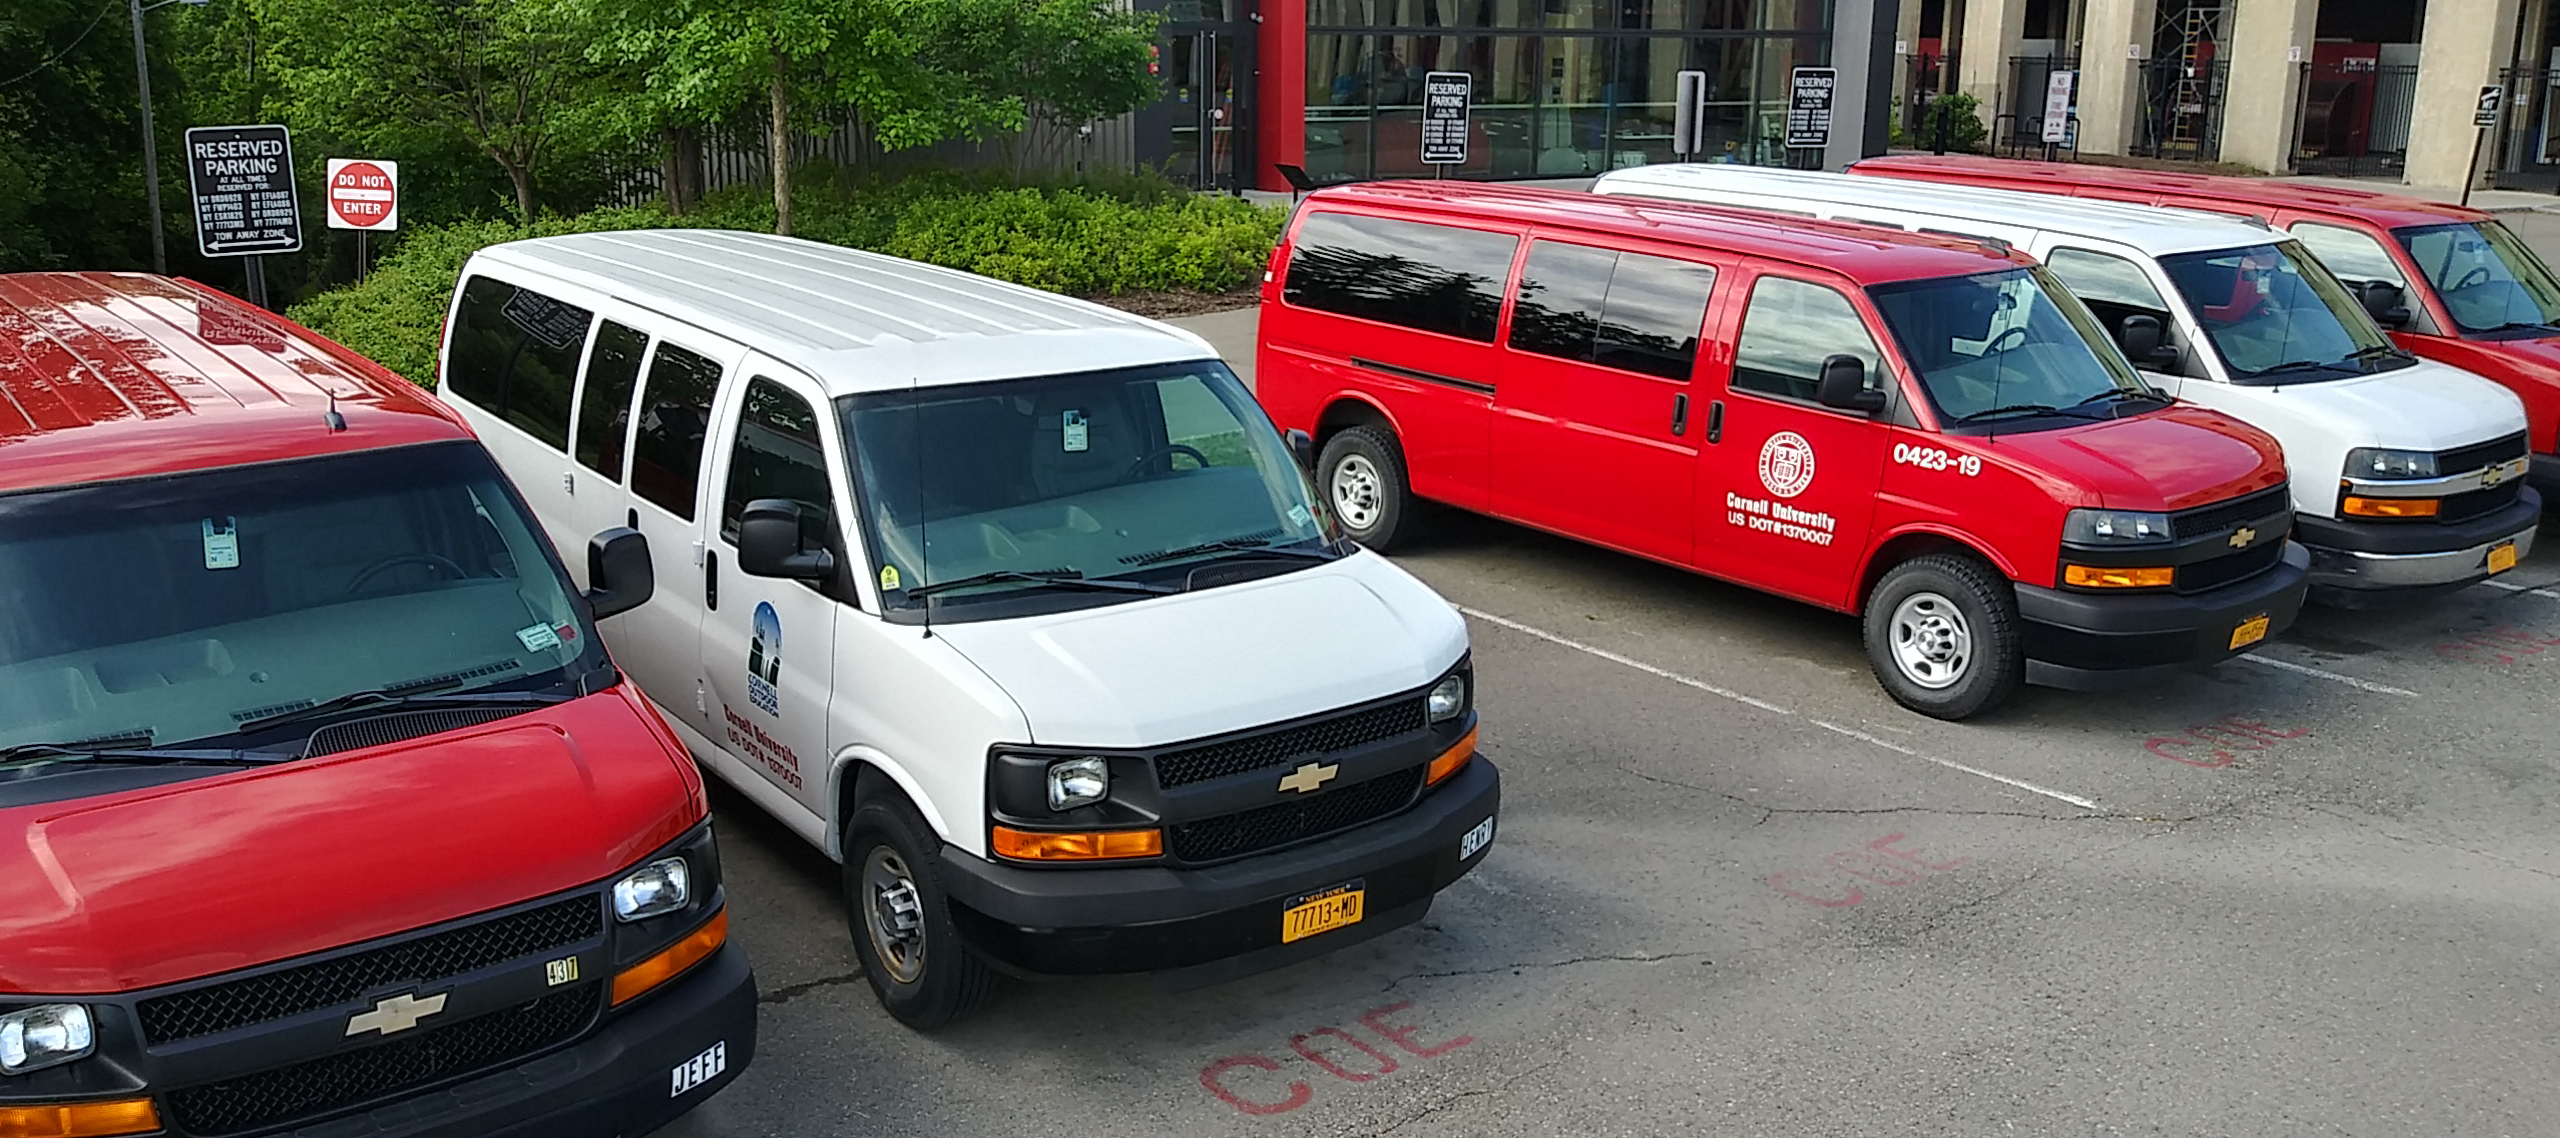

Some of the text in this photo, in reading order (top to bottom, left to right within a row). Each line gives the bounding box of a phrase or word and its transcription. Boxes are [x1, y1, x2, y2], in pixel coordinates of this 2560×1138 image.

[1429, 83, 1467, 95] RESERVED
[1795, 77, 1832, 88] RESERVED
[1431, 95, 1463, 107] PARKING
[1797, 88, 1829, 99] PARKING
[194, 140, 283, 159] RESERVED
[205, 158, 277, 176] PARKING
[217, 184, 253, 192] RESERVED
[338, 174, 386, 188] DO NOT
[343, 202, 381, 215] ENTER
[214, 228, 286, 240] TOW AWAY ZONE
[1893, 442, 1981, 477] 0423-19
[1727, 492, 1836, 533] Cornell University
[1728, 510, 1746, 526] US
[748, 673, 778, 700] CORNELL
[723, 703, 799, 772] Cornell University
[727, 727, 741, 746] US
[1768, 832, 1973, 908] COE
[1305, 887, 1346, 904] NEW YORK
[549, 957, 576, 983] 437
[1199, 1001, 1476, 1116] COE
[674, 1043, 723, 1094] JEFF
